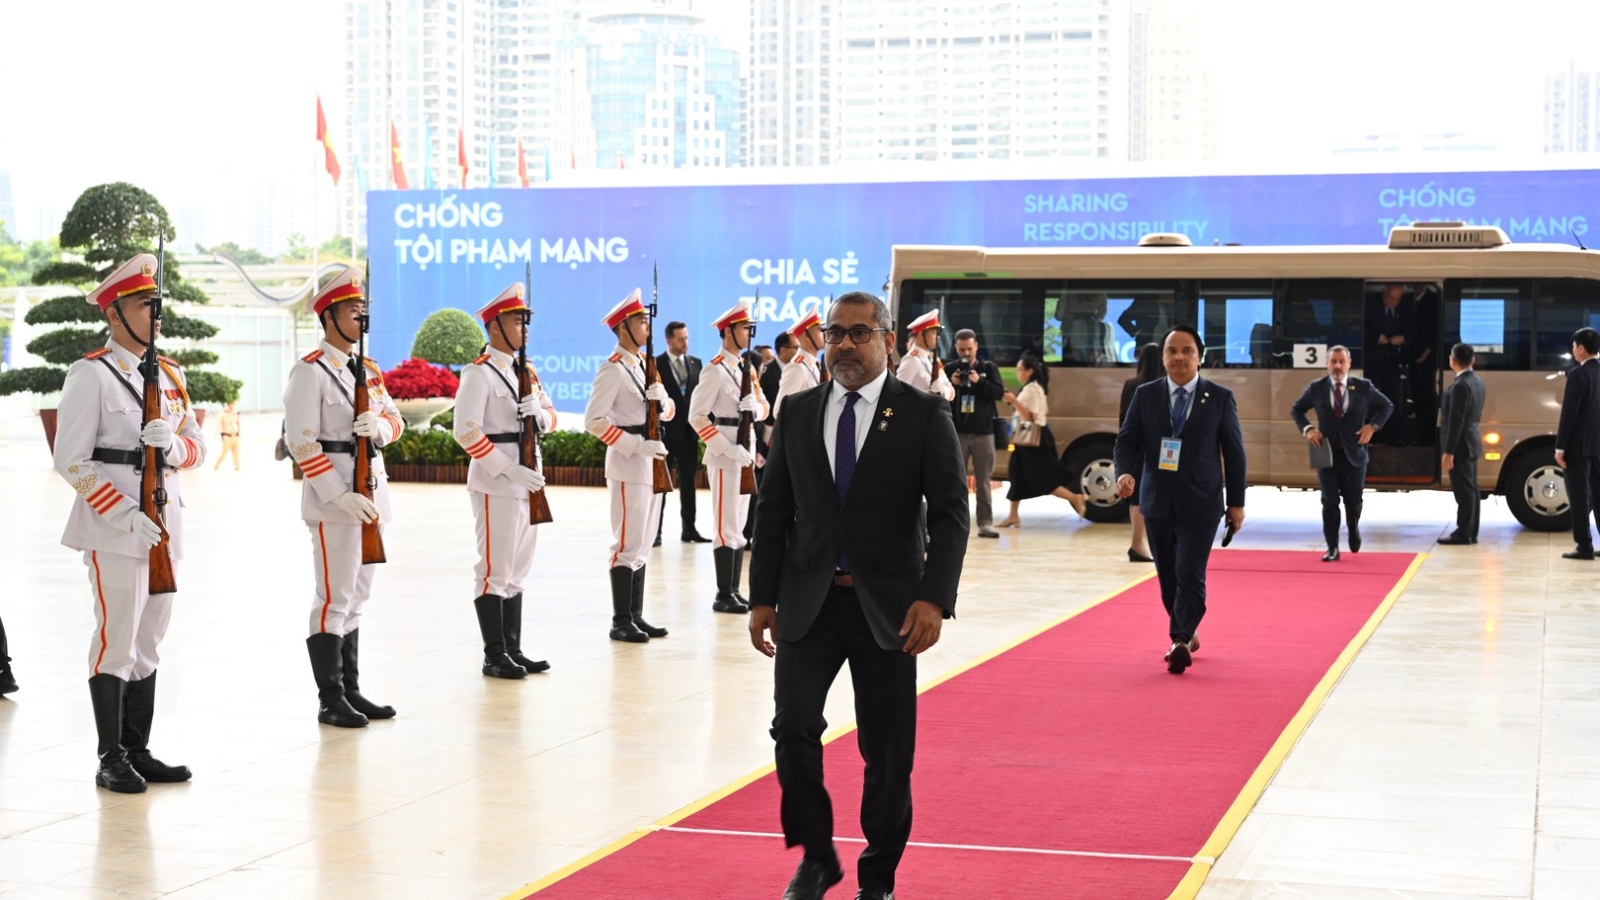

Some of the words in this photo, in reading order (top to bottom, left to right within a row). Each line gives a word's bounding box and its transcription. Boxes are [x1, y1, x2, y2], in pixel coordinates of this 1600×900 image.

[1024, 192, 1128, 213] SHARING
[1378, 181, 1476, 208] CHỐNG
[394, 193, 503, 228] CHỐNG
[1510, 215, 1589, 241] MẠNG
[394, 233, 442, 271] TỘI
[450, 237, 532, 270] PHẠM
[540, 236, 629, 270] MẠNG
[739, 258, 816, 285] CHIA
[822, 250, 859, 285] SẺ
[531, 354, 608, 373] COUNT
[1305, 346, 1318, 364] 3
[543, 381, 594, 400] YBER
